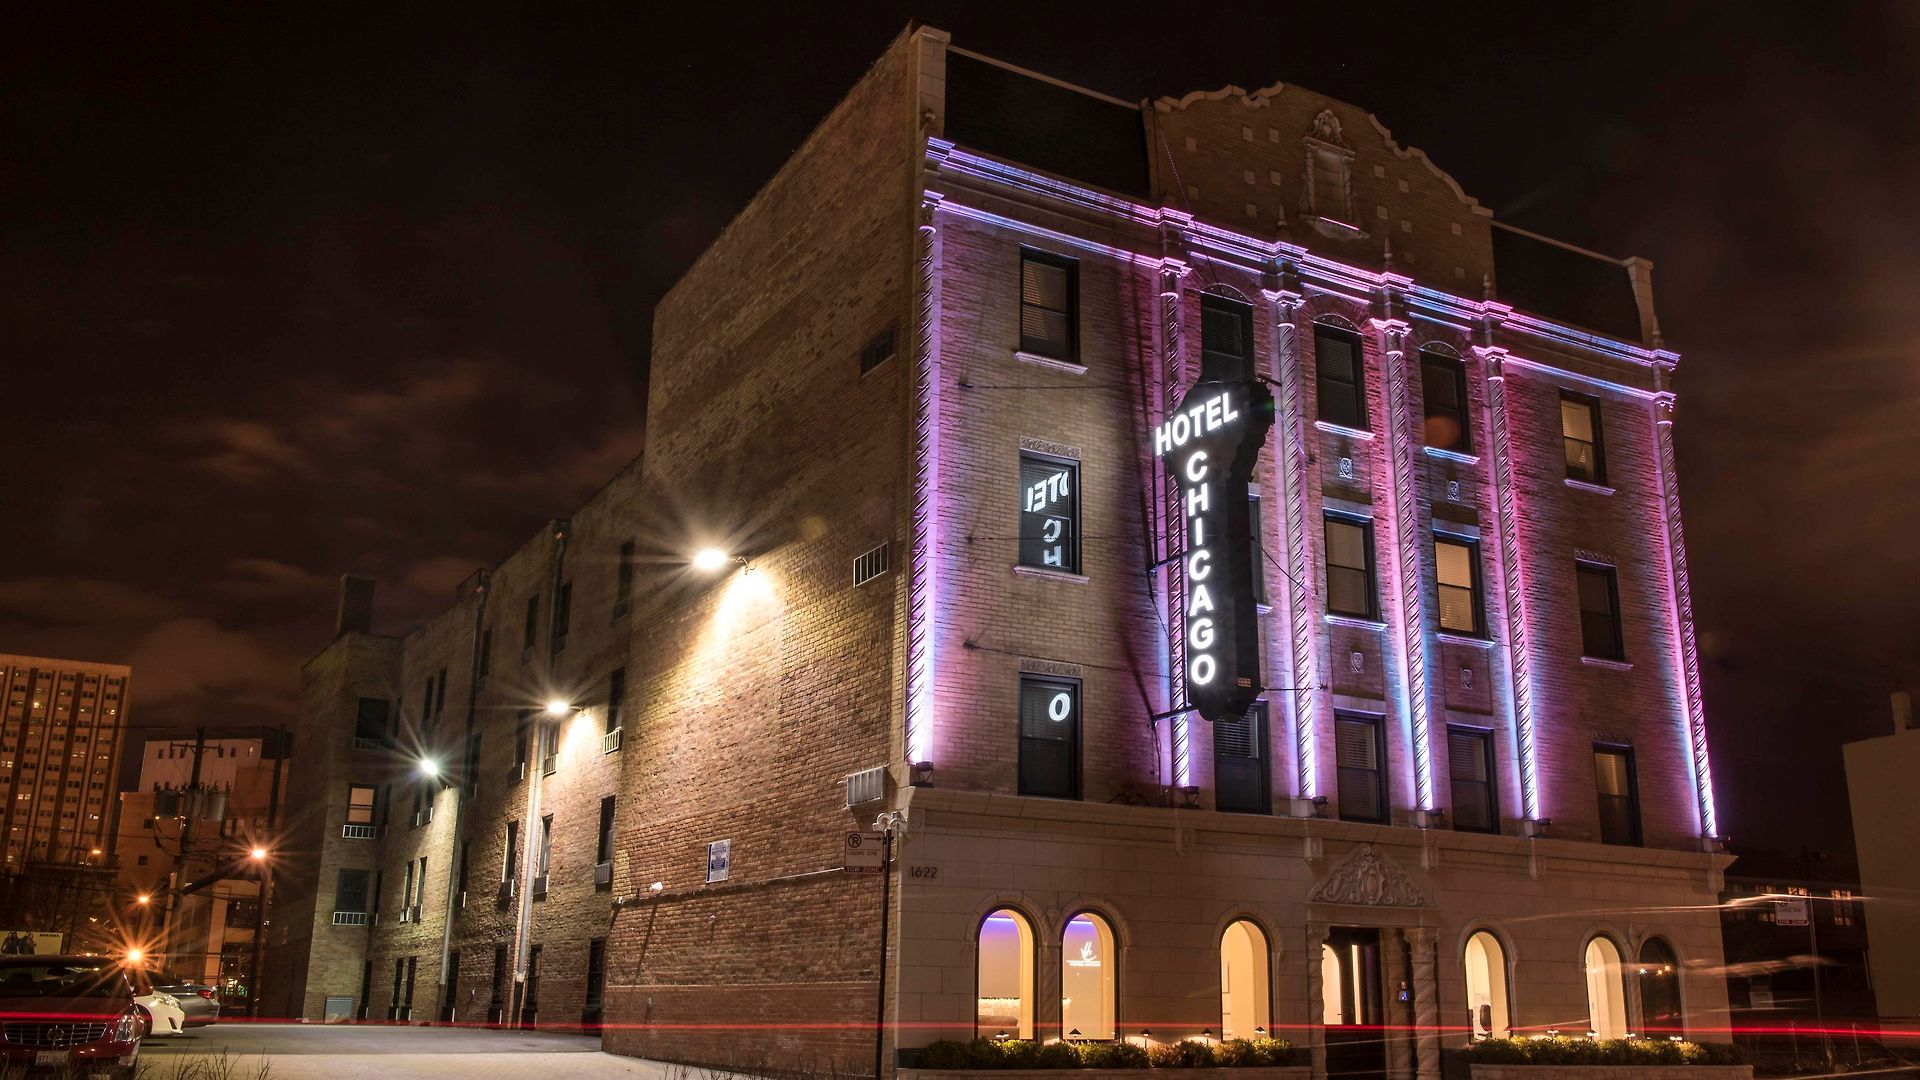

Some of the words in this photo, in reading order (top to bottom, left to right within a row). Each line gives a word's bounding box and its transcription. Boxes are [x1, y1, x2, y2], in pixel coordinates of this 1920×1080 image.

[1156, 393, 1237, 455] HOTEL
[1186, 451, 1215, 685] CHICAGO
[910, 865, 937, 878] 1622
